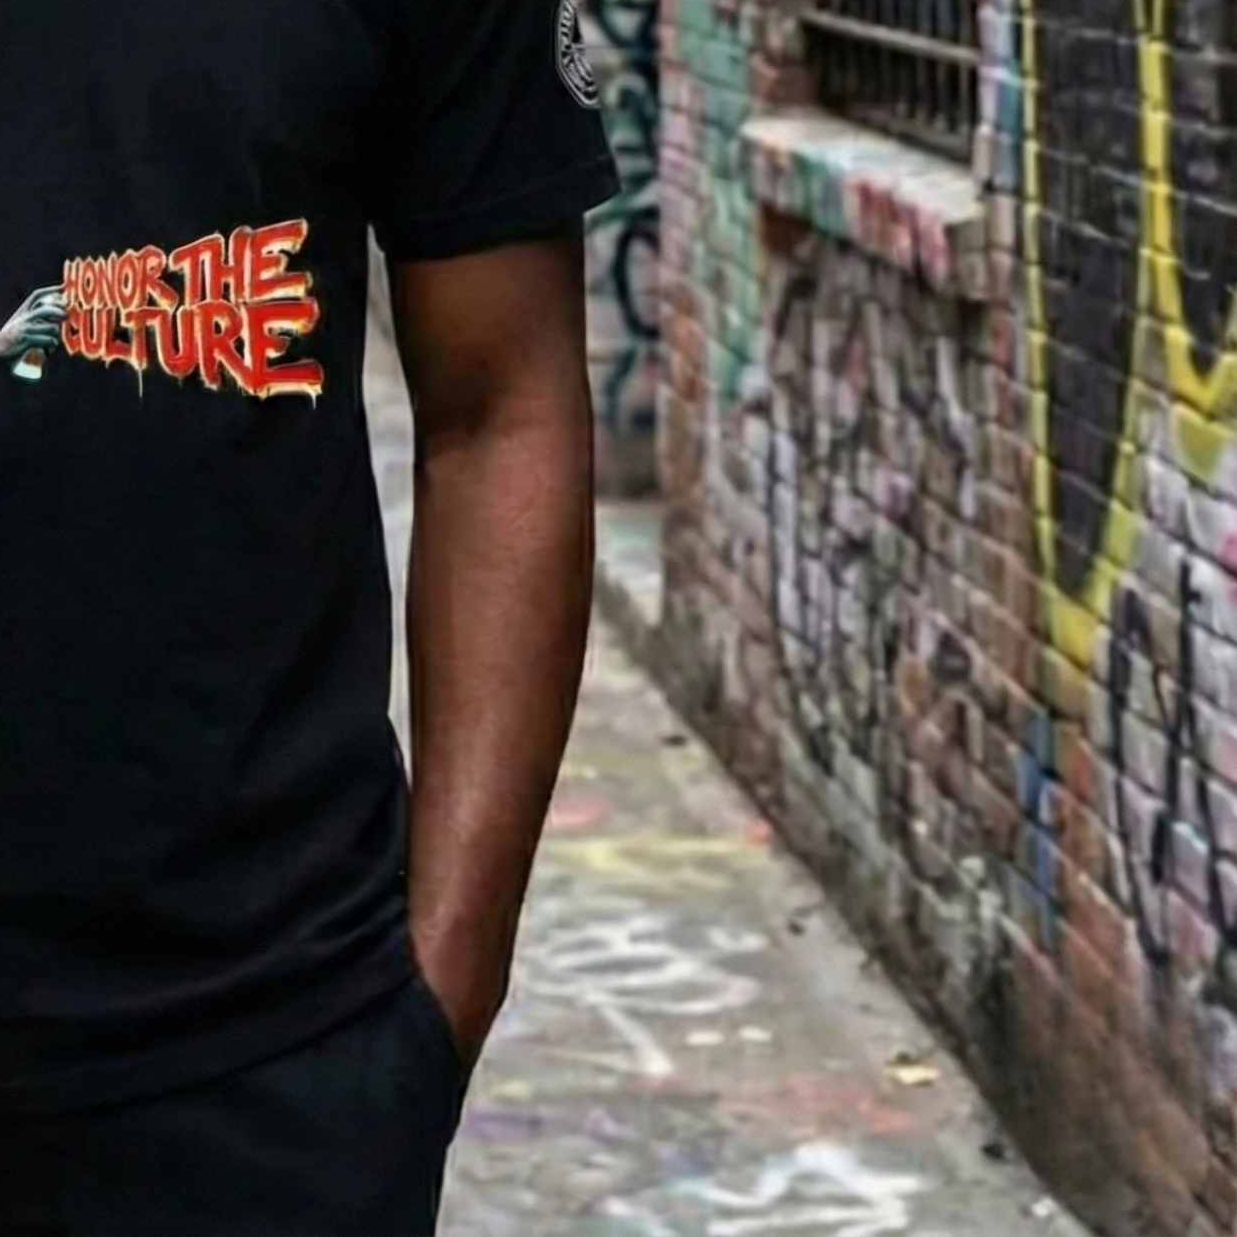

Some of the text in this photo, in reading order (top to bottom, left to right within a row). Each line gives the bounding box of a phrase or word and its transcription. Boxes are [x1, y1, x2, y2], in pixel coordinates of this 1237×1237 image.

[63, 217, 312, 310] HONOR THE
[62, 298, 324, 400] CULTURE
